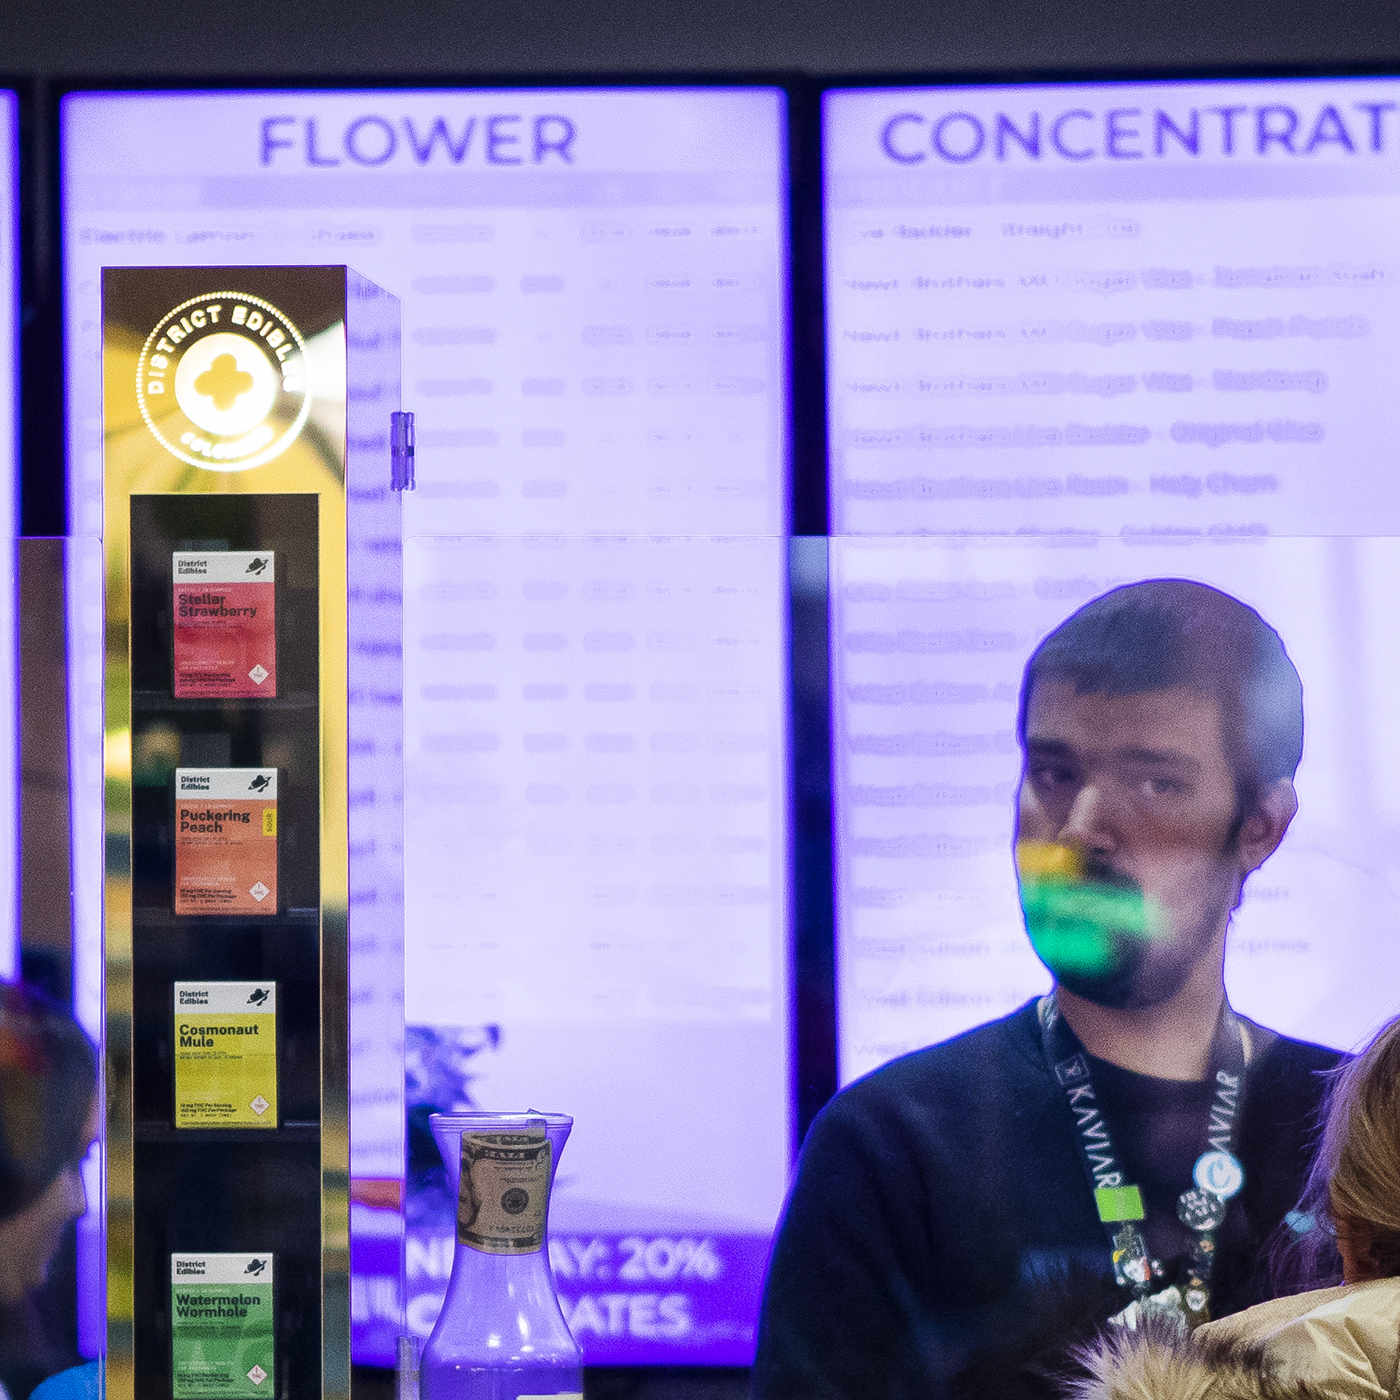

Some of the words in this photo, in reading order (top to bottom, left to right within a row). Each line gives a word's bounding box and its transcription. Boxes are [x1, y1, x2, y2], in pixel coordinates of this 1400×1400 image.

[258, 113, 578, 170] FLOWER
[146, 304, 223, 395] DISTRICT
[178, 593, 226, 605] Stellar
[178, 605, 258, 618] Strawberry
[180, 809, 251, 824] Puckering
[180, 821, 223, 833] Peach
[179, 1024, 259, 1035] Cosmonaut
[179, 1035, 214, 1047] Mule
[1208, 1070, 1240, 1152] AVIAR
[617, 1235, 722, 1282] 20%
[176, 1294, 261, 1306] Watermelon
[176, 1306, 248, 1318] Wormhole
